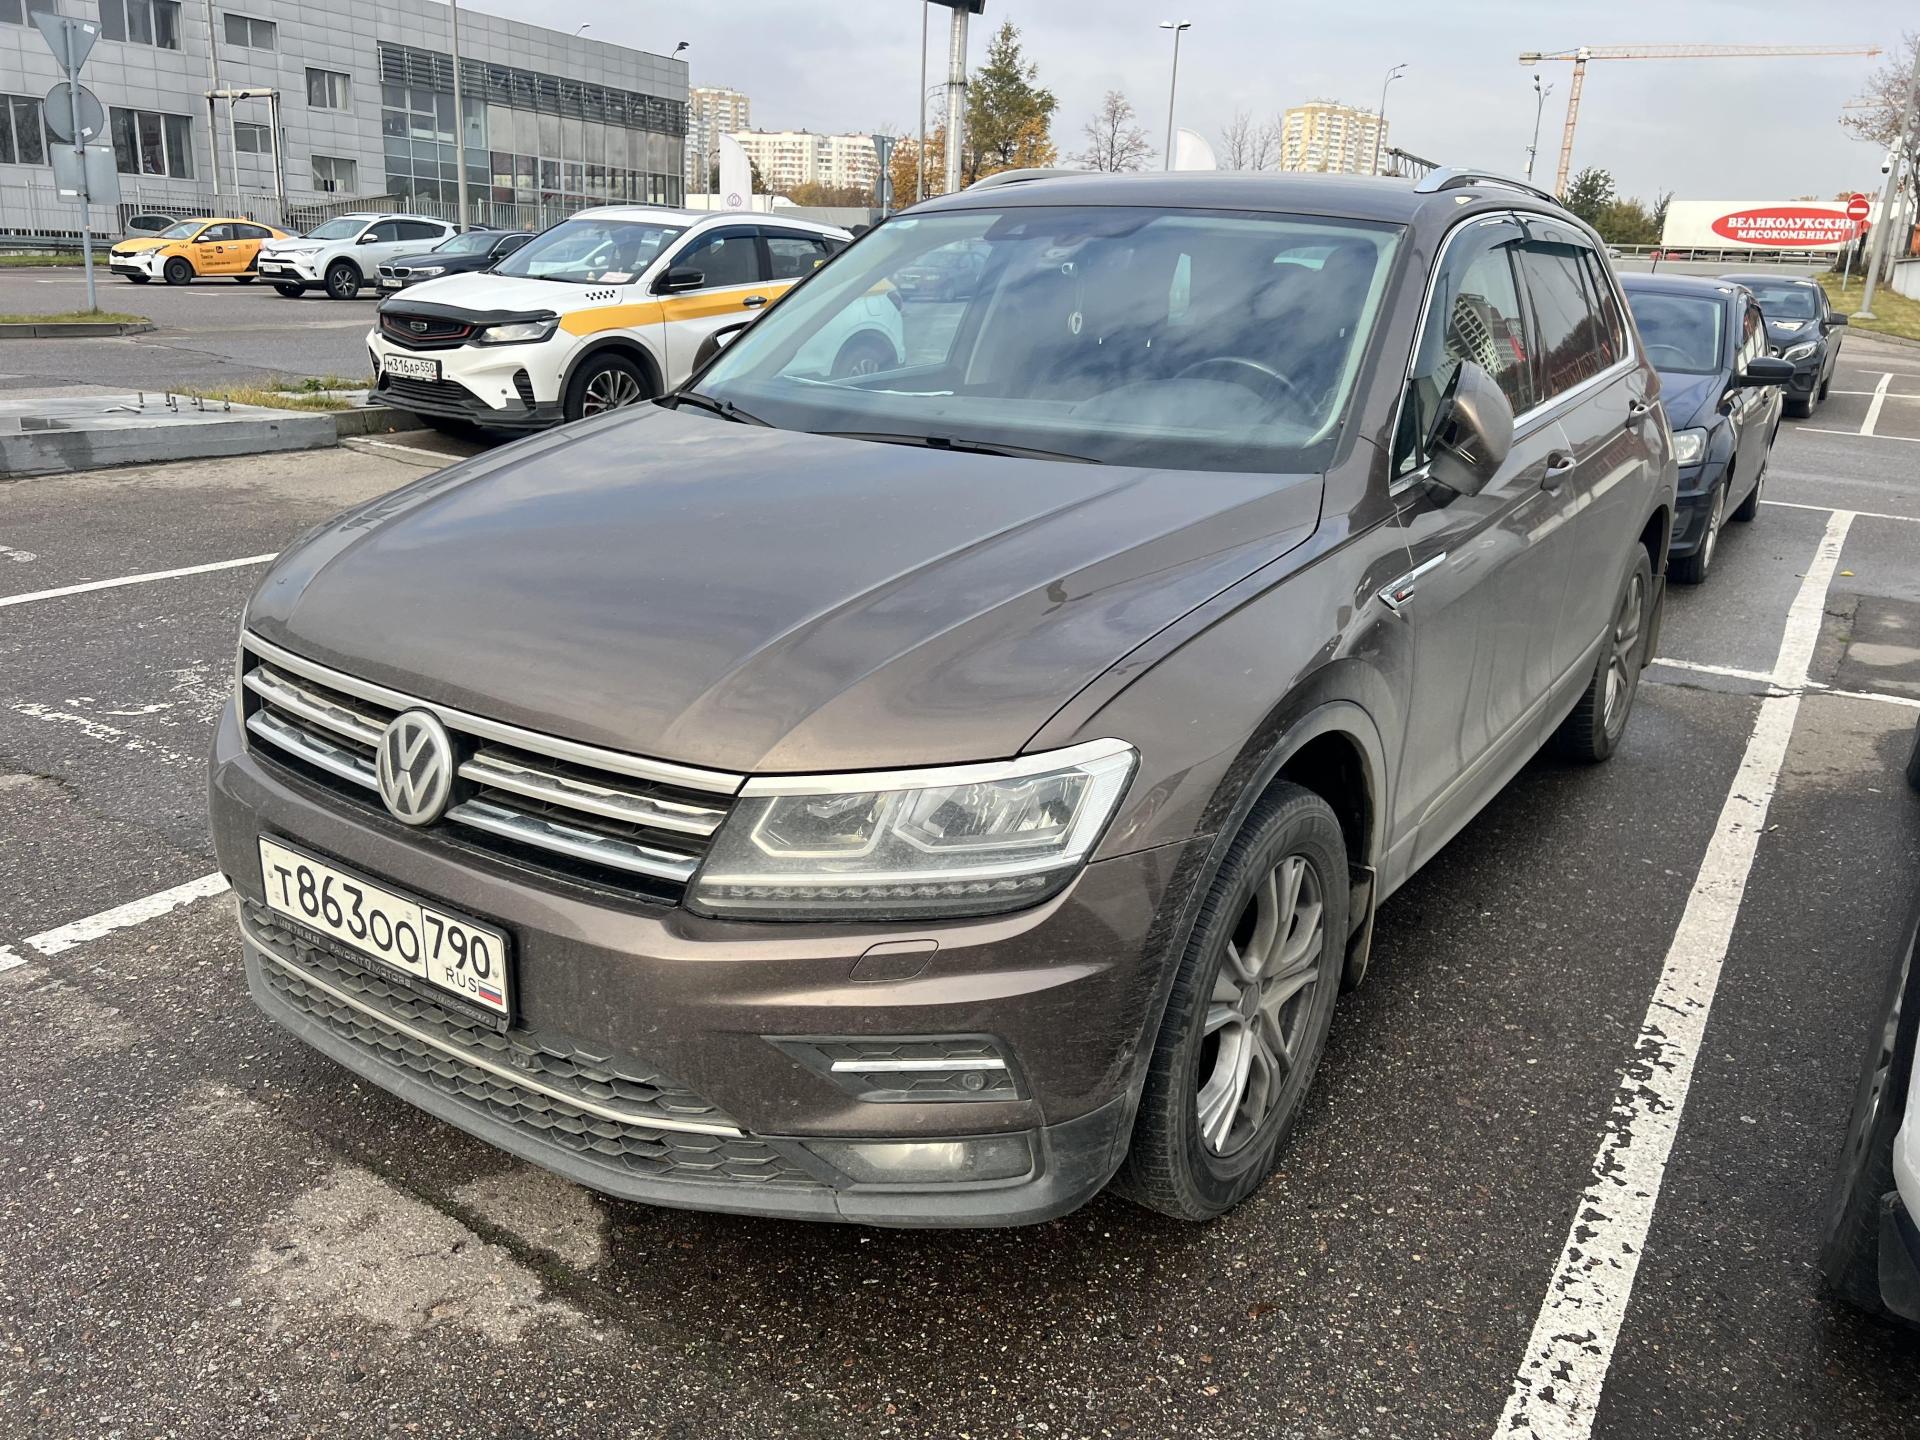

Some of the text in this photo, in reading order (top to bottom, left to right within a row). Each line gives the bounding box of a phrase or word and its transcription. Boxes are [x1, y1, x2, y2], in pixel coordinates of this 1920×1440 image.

[1736, 229, 1842, 240] МЯСОКОМБИНАТ
[425, 914, 491, 980] 790
[445, 967, 477, 993] RUS
